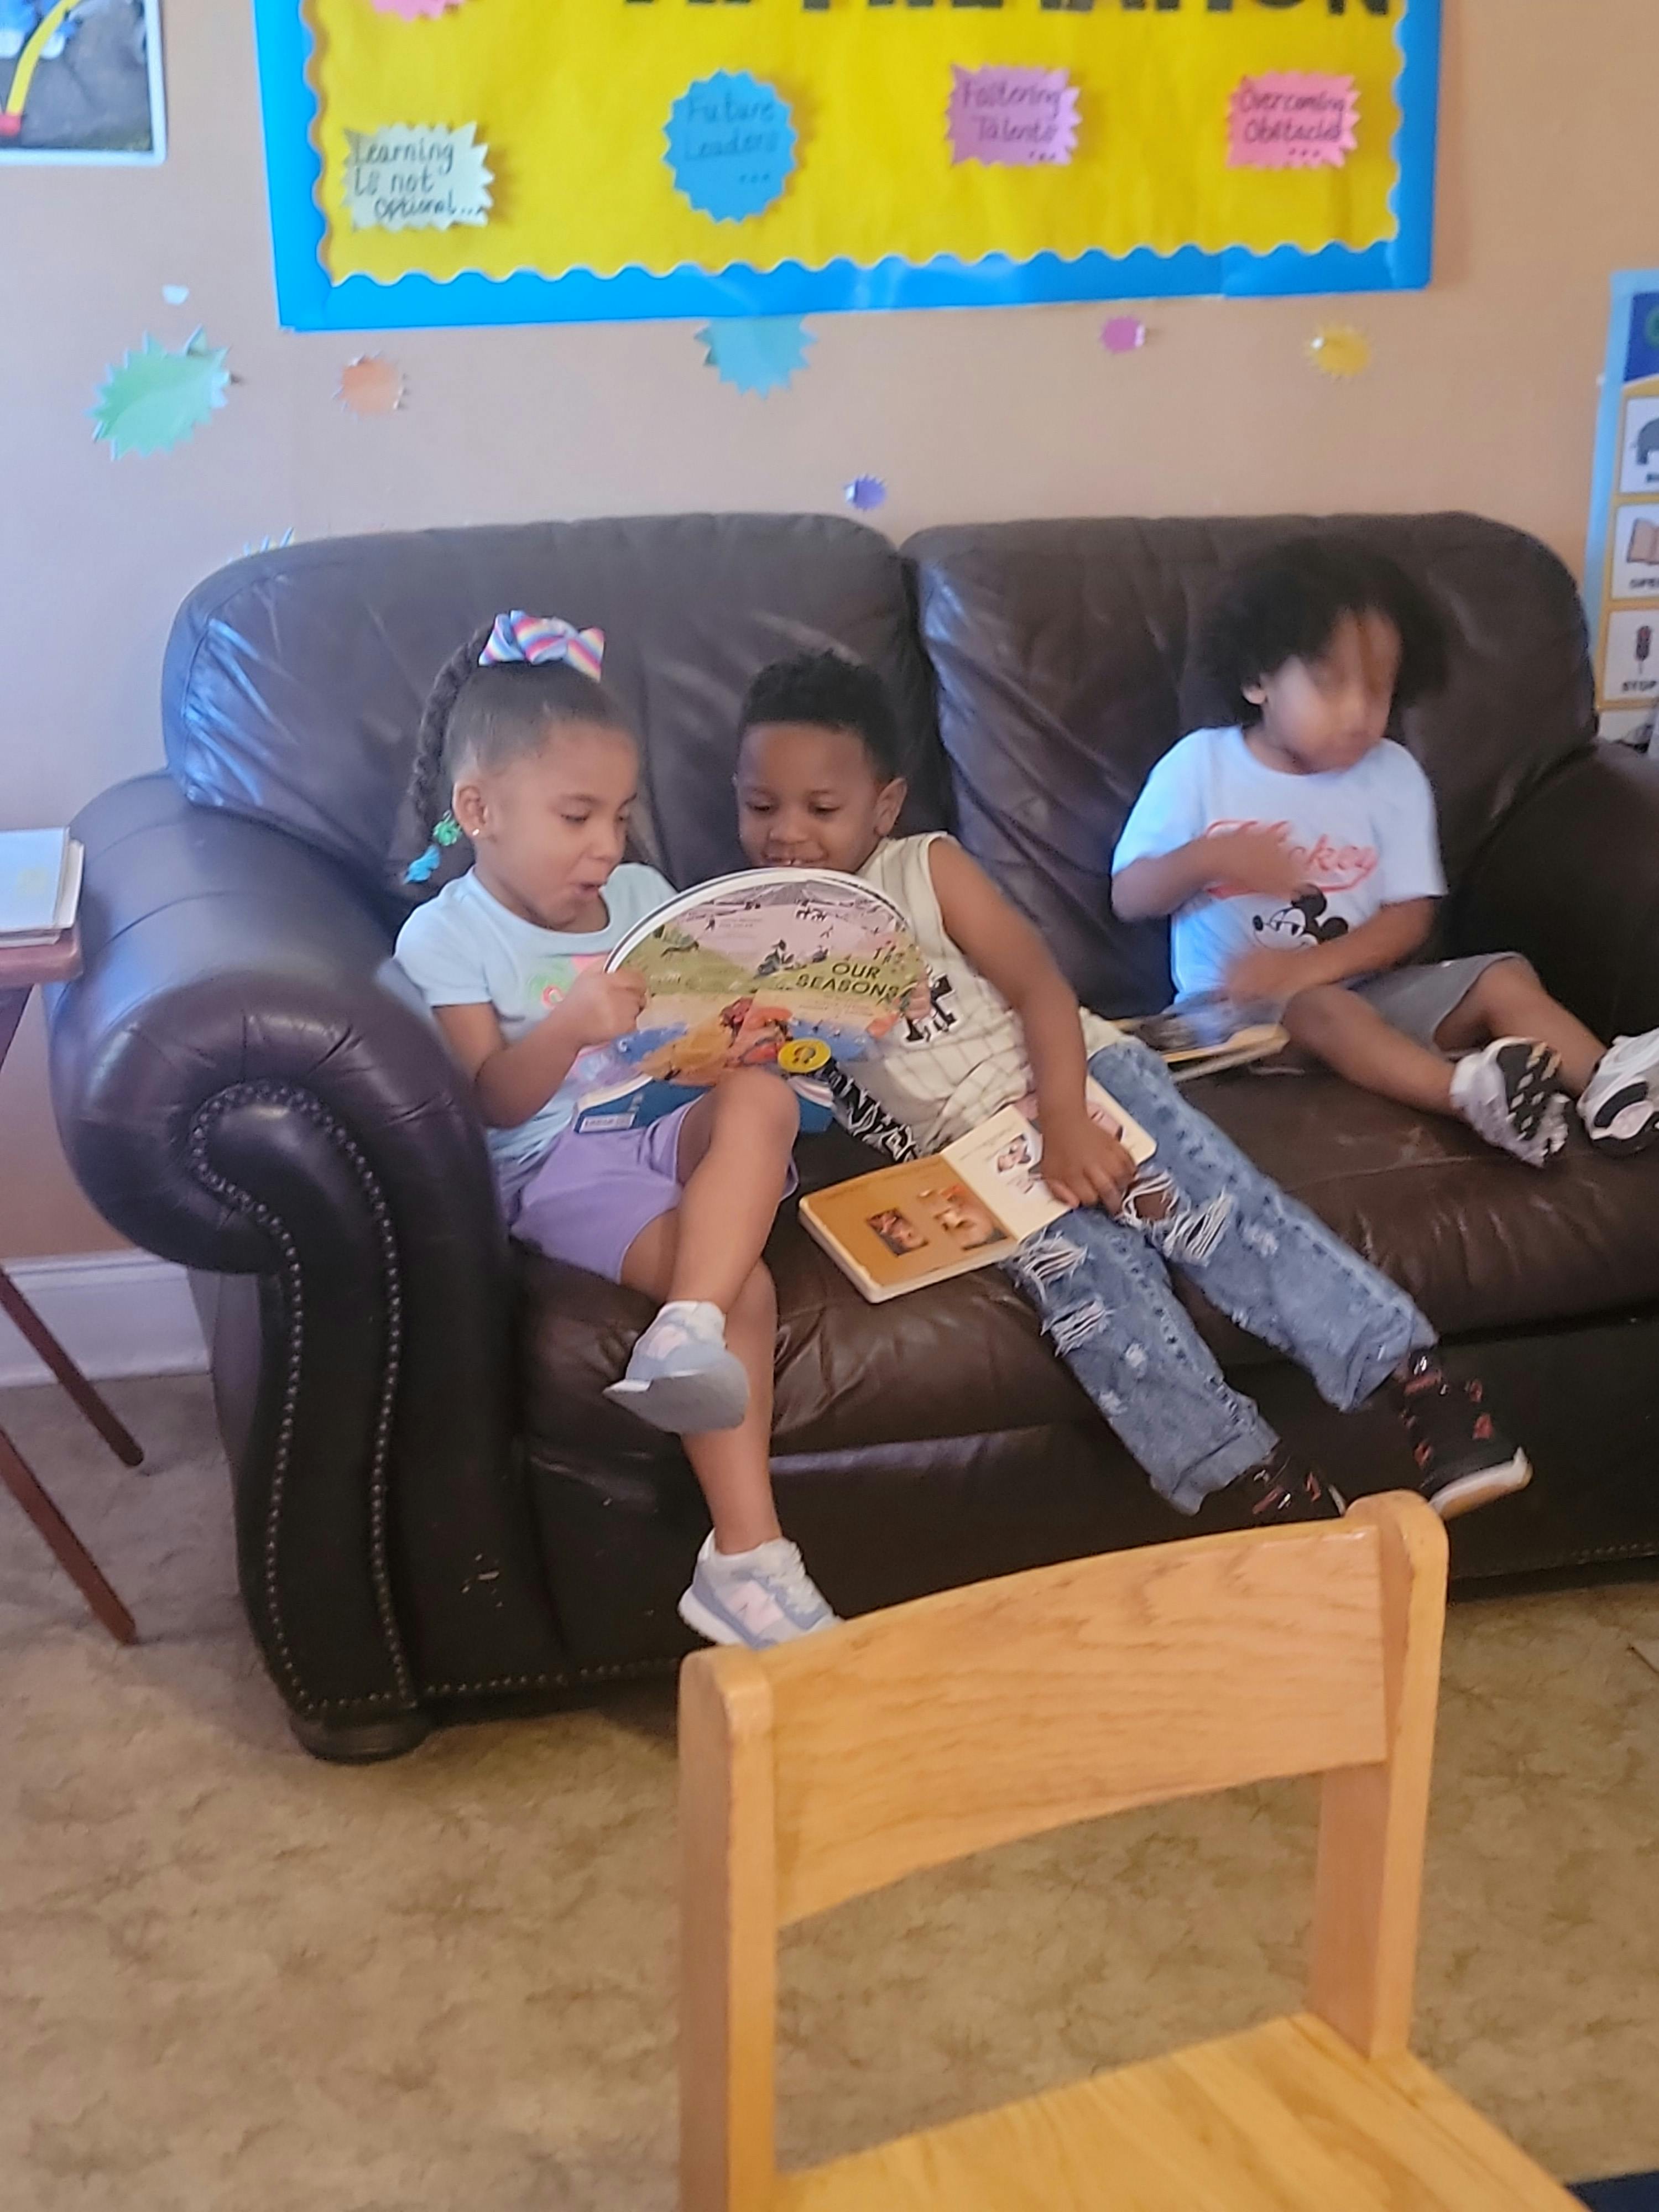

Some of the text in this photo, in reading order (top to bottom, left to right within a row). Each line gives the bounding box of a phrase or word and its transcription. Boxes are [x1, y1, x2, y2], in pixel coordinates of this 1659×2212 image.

[687, 90, 774, 124] Future
[963, 81, 1061, 119] Fostering
[1240, 89, 1345, 125] Overcoming
[354, 137, 454, 175] Learning
[684, 128, 778, 161] Leaders
[390, 165, 434, 193] not
[1623, 680, 1657, 692] STOP
[796, 973, 900, 1000] SEASONS
[832, 962, 881, 980] OUR
